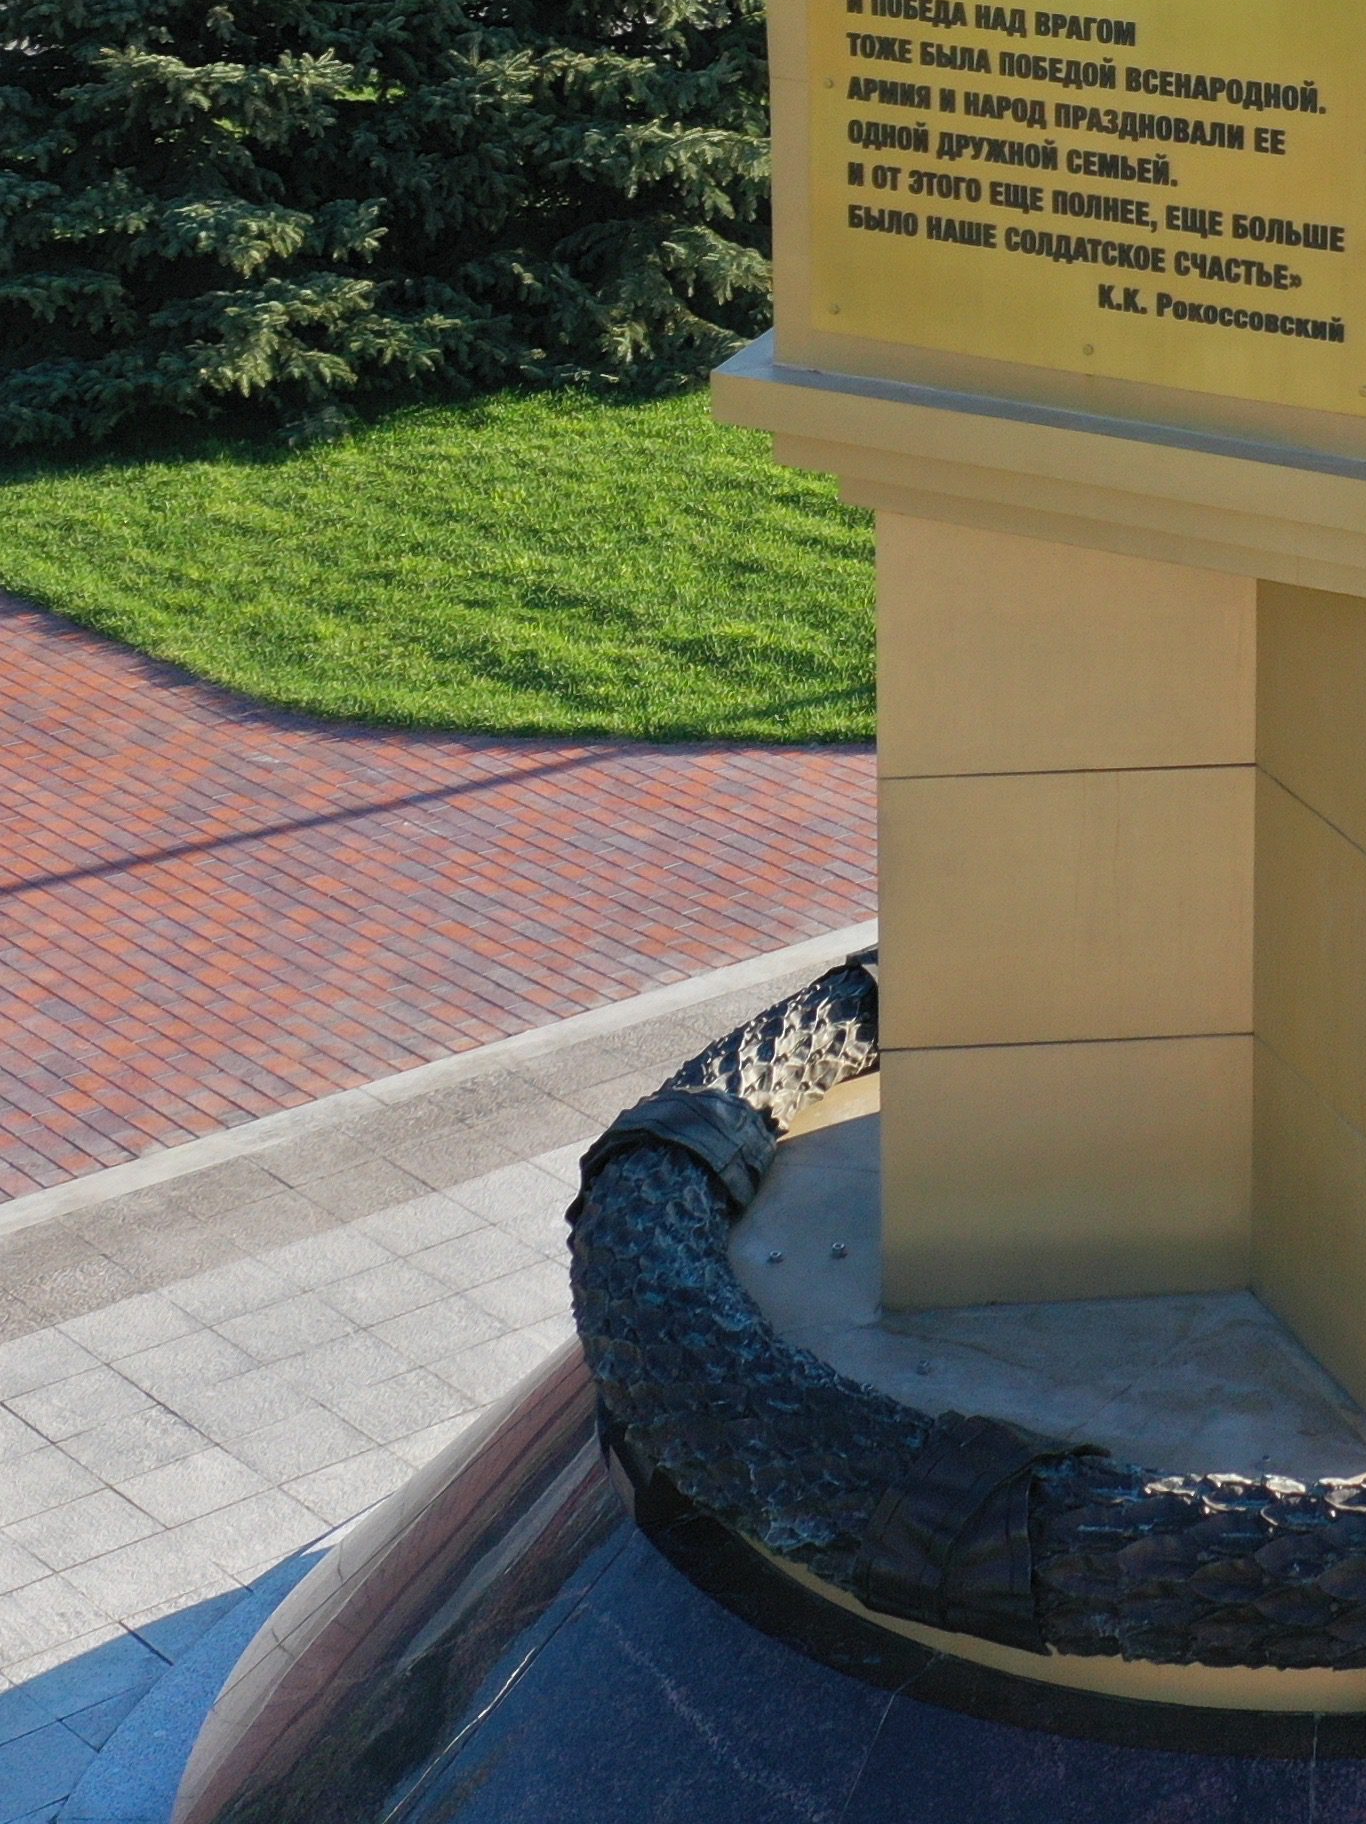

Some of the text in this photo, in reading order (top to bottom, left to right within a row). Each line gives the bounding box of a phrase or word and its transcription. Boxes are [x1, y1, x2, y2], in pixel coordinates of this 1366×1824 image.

[974, 4, 1027, 38] НАД
[1034, 11, 1136, 47] ВРАГОМ
[846, 31, 1327, 115] ТОЖЕ БЫЛА ПОБЕДОЙ ВСЕНАРОДНОЙ.
[847, 76, 1286, 156] АРМИЯ И НАРОД ПРАЗДНОВАЛИ ЕЕ
[847, 119, 1178, 187] ОДНОЙ ДРУЖНОЙ СЕМЬЕЙ.
[847, 161, 1345, 253] И ОТ ЭТОГО ЕЩЕ ПОЛНЕЕ, ЕЩЕ БОЛЬШЕ
[847, 204, 1302, 291] БЫЛО НАШЕ СОЛДАТСКОЕ СЧАСТЬЕ»
[1098, 283, 1345, 344] К.К. Рокоссовский
